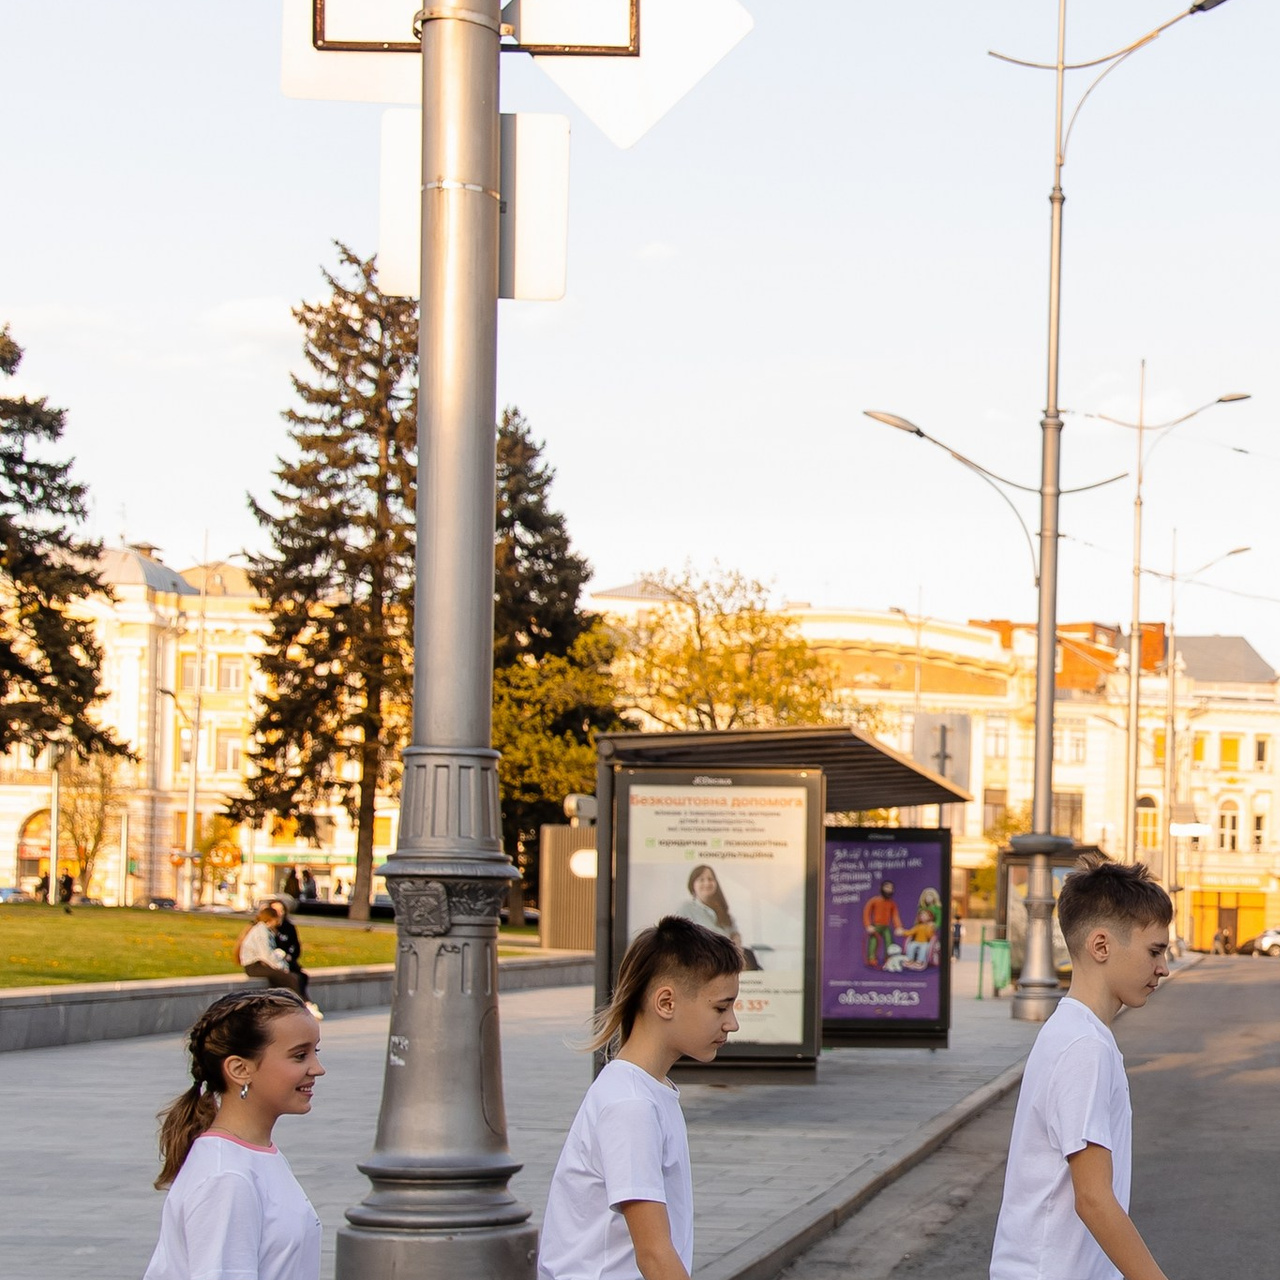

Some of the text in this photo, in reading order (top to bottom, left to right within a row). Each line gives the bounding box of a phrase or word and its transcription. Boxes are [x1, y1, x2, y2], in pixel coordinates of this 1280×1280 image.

[629, 794, 803, 808] Безкоштовна допомога
[658, 839, 707, 848] юридична
